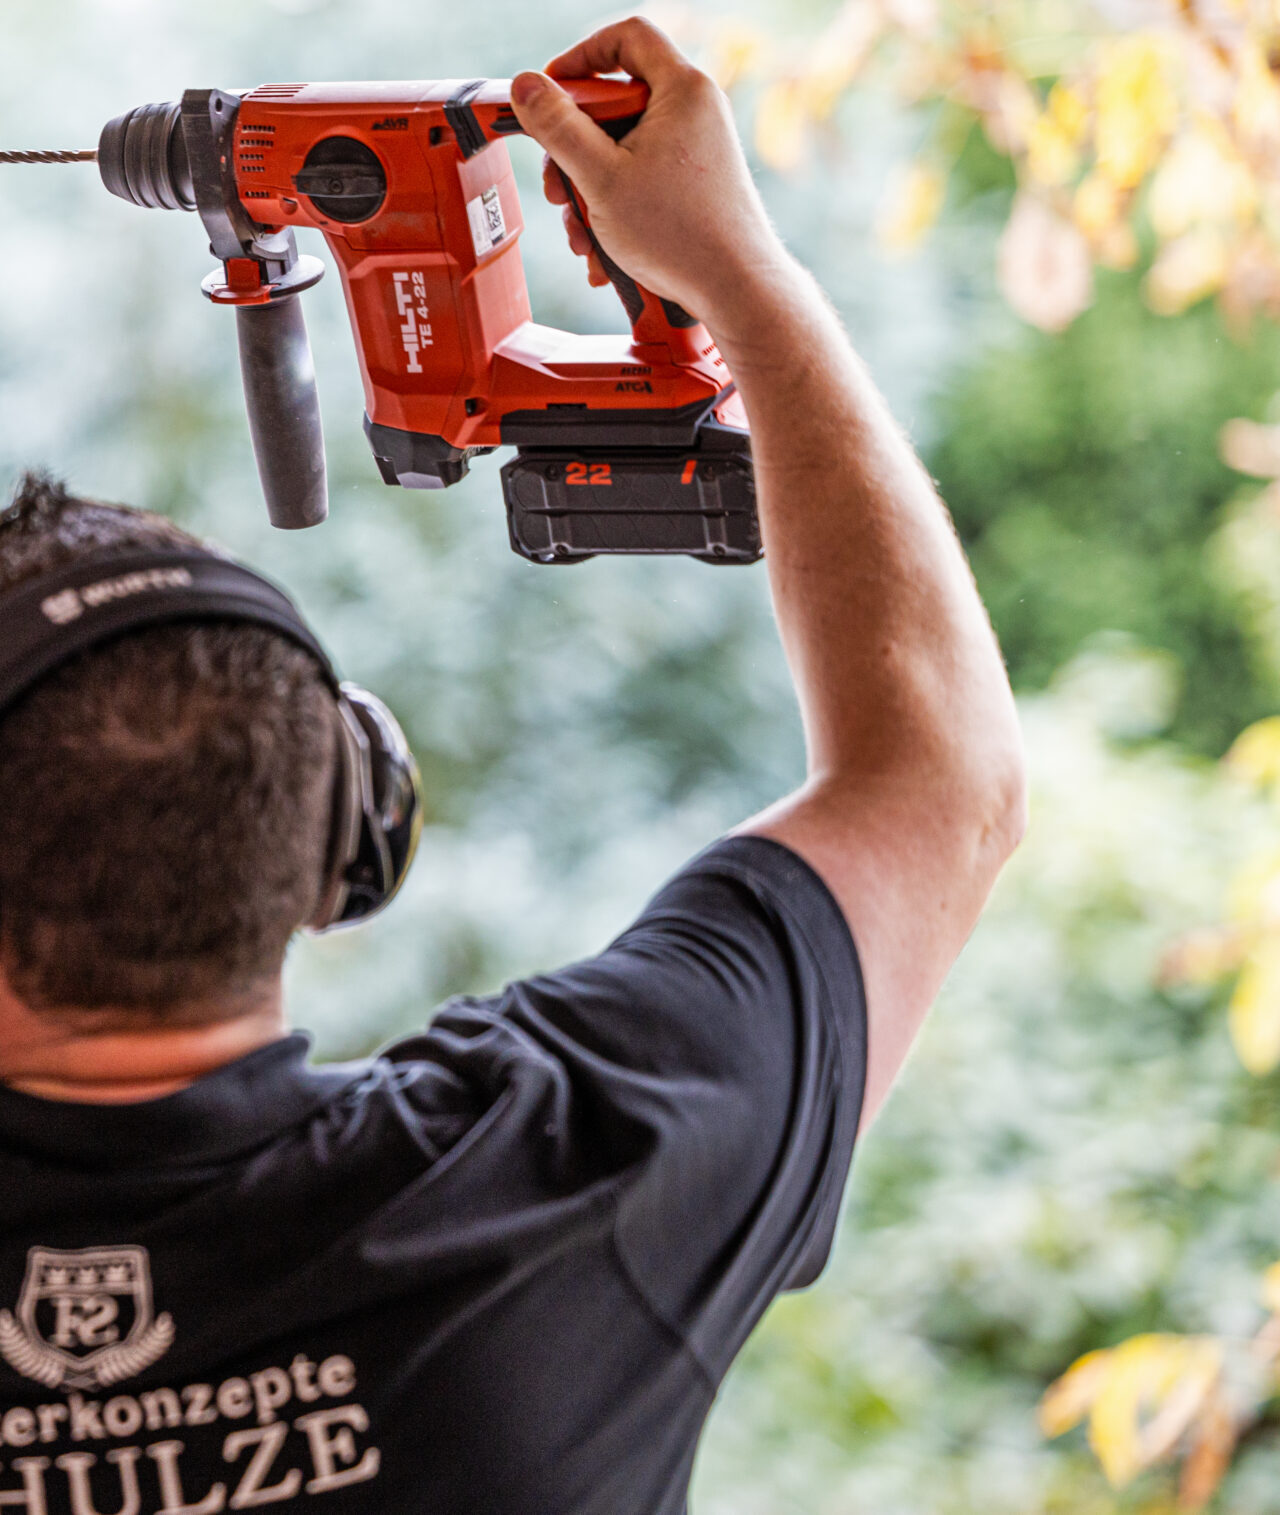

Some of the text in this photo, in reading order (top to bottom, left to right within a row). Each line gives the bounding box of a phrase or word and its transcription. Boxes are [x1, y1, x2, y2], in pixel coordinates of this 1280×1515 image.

[392, 272, 423, 373] HILTI
[411, 271, 434, 349] TE 4-22
[565, 461, 613, 486] 22
